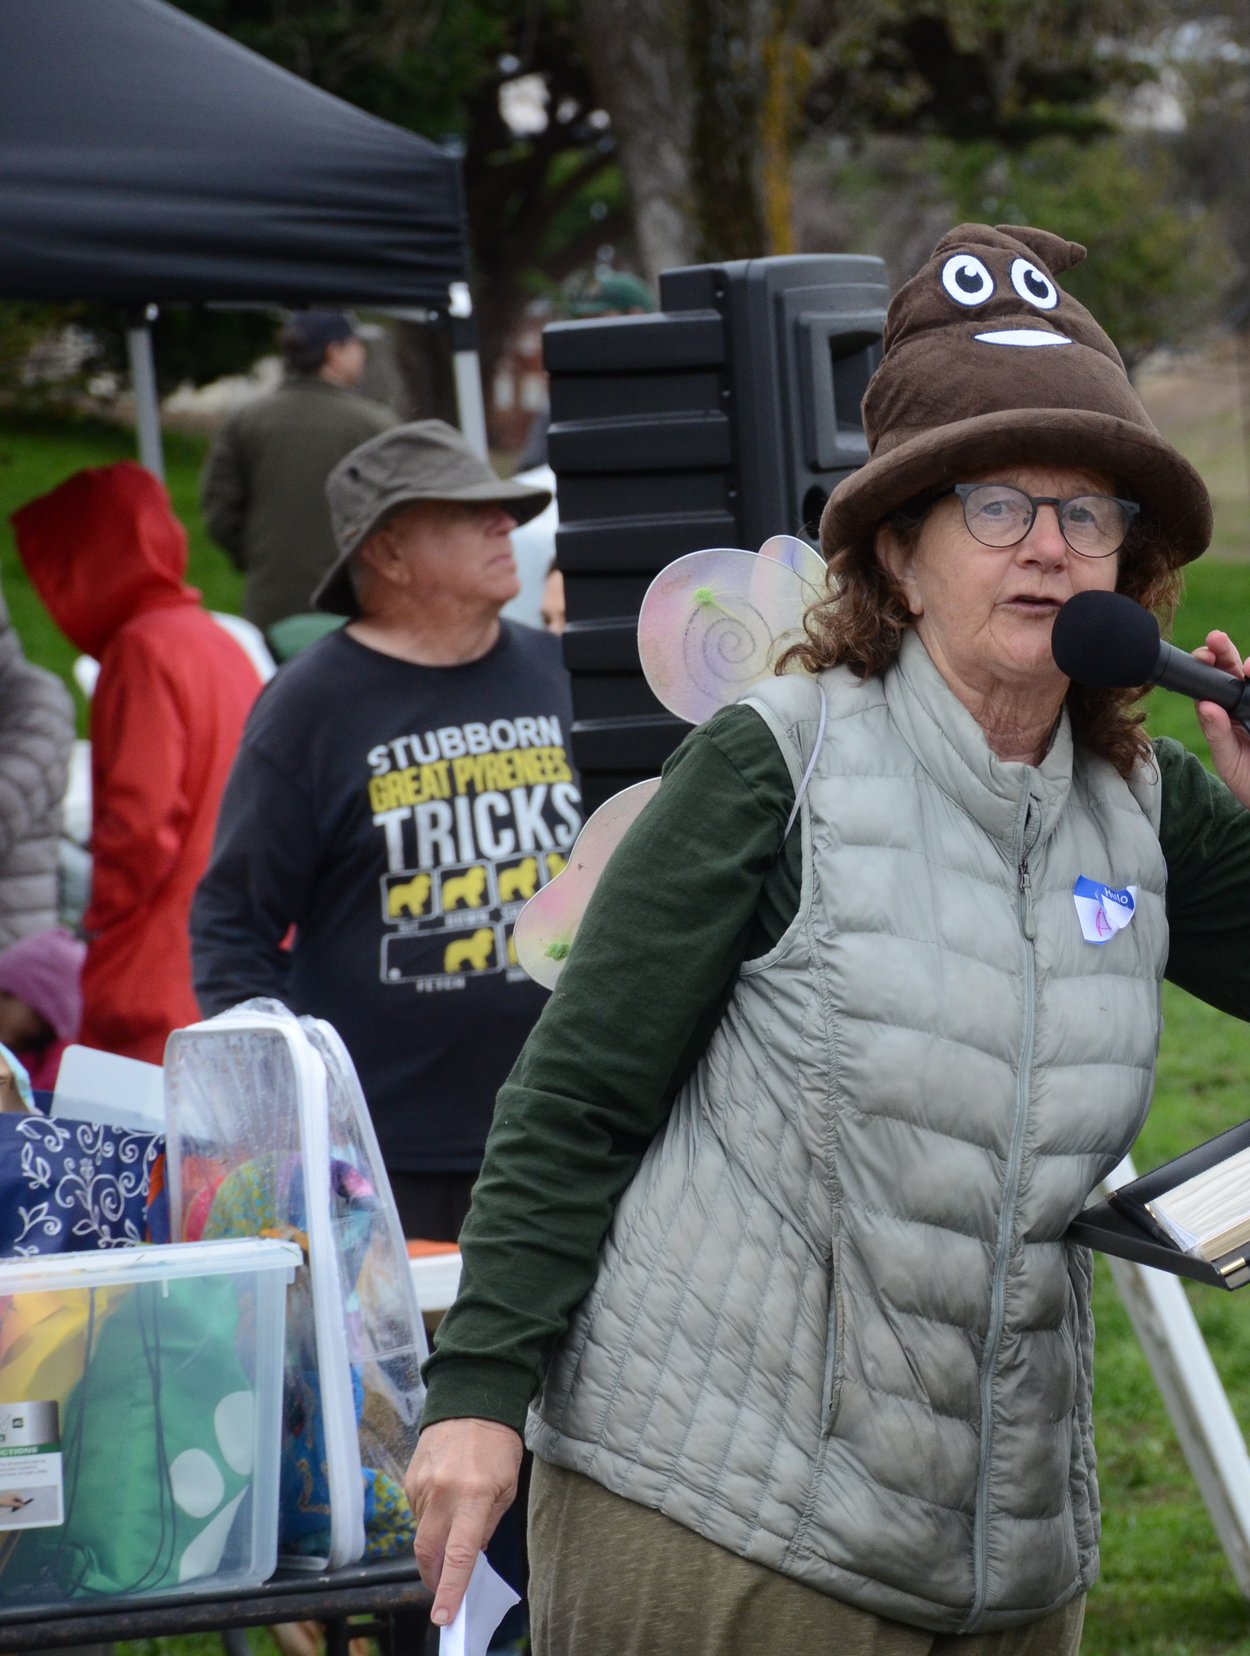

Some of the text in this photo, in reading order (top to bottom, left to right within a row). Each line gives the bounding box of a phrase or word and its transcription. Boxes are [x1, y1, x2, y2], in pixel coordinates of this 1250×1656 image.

[367, 715, 564, 776] STUBBORN
[368, 746, 573, 814] GREAT PYRENEES
[373, 782, 582, 873] TRICKS
